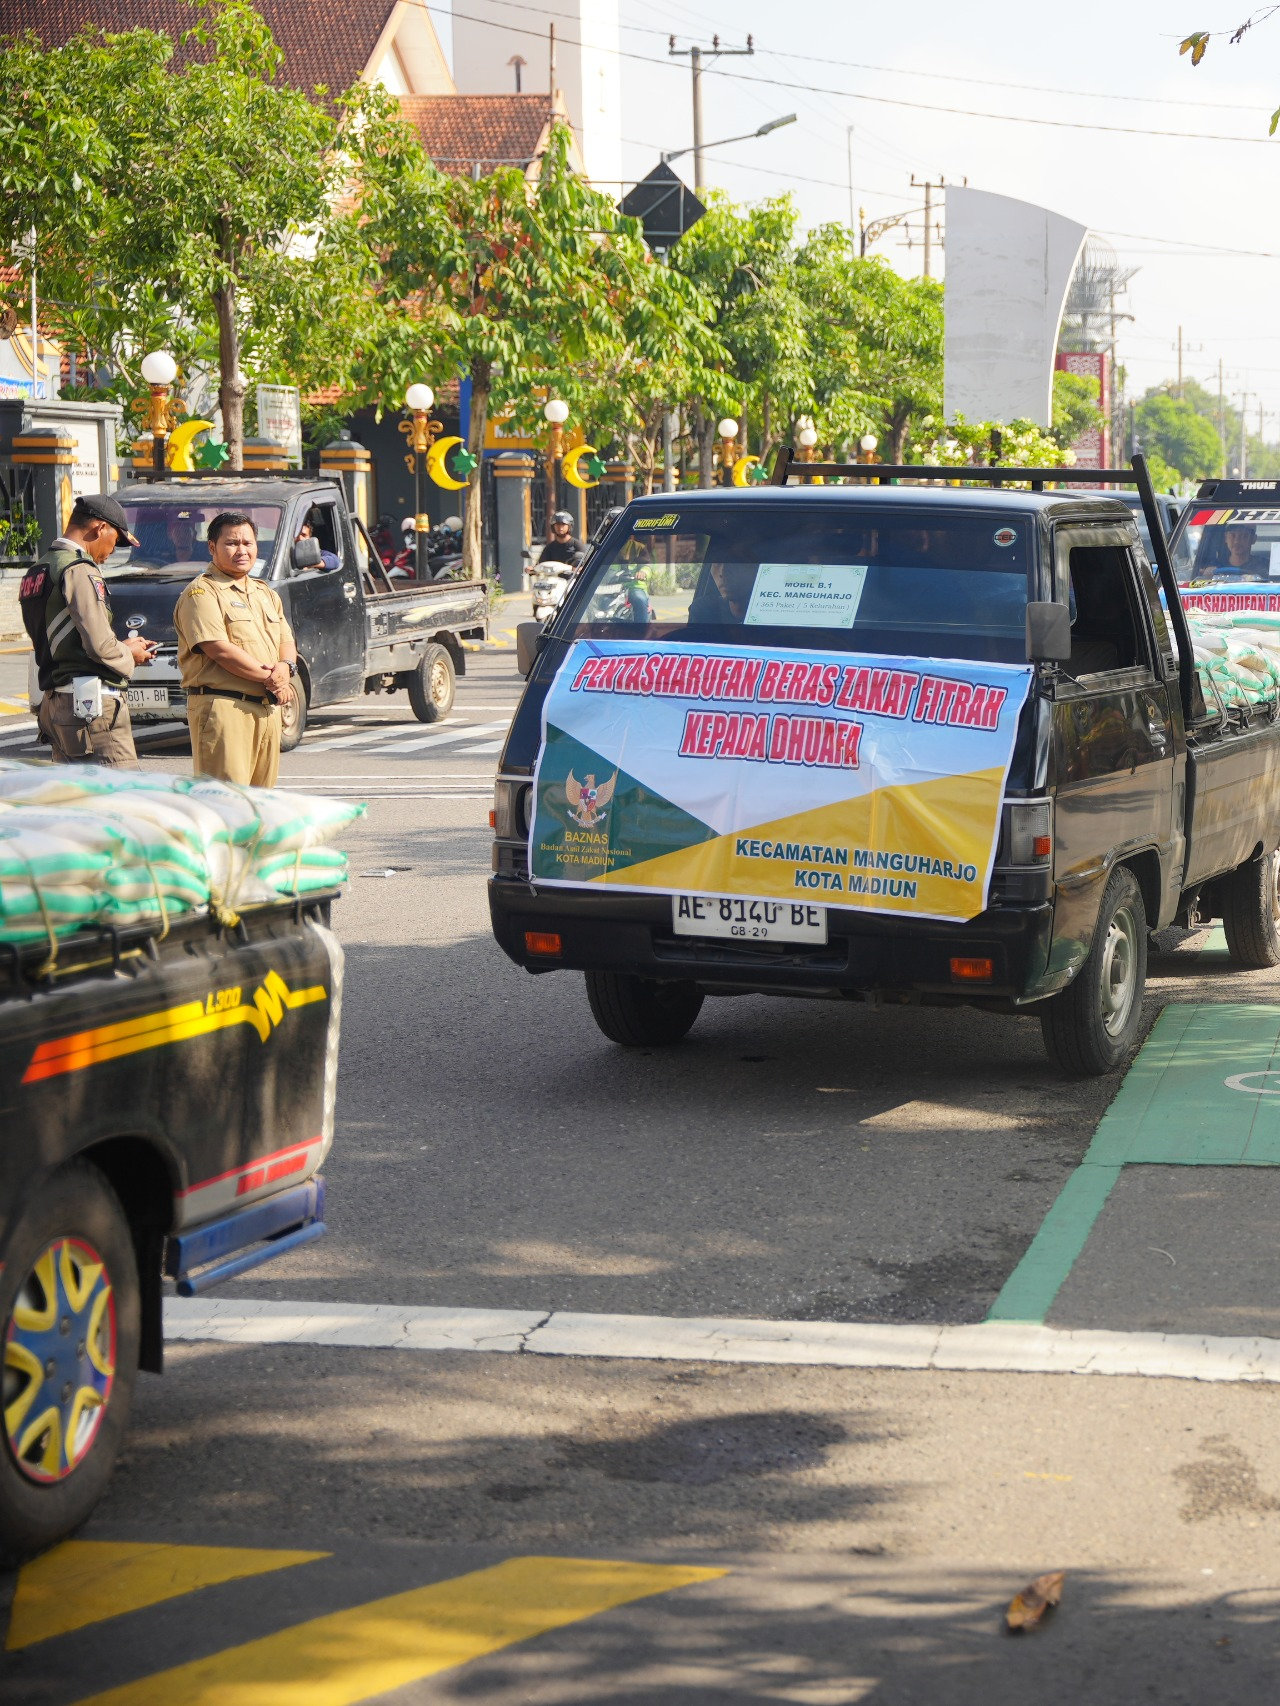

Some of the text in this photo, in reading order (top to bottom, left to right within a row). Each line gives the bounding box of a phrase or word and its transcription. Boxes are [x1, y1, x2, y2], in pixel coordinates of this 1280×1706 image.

[1241, 481, 1278, 490] THULE
[784, 591, 853, 600] MANGUHARJO
[1181, 593, 1267, 613] NTASHARUFAN
[126, 689, 167, 702] 601 BH
[570, 653, 1009, 732] PENTASHARUFAN BERAS ZAKAT FITRAH
[678, 709, 865, 770] KEPADA DHUAFA
[564, 831, 609, 845] BAZNAS
[541, 843, 633, 857] Badan Amil Zakat Nasional
[556, 854, 615, 866] KOTA MADIUN
[735, 838, 978, 882] KECAMATAN MANGUHARJO
[794, 869, 918, 899] KOTA MADIUN
[678, 896, 706, 920] AE
[790, 903, 820, 927] BE
